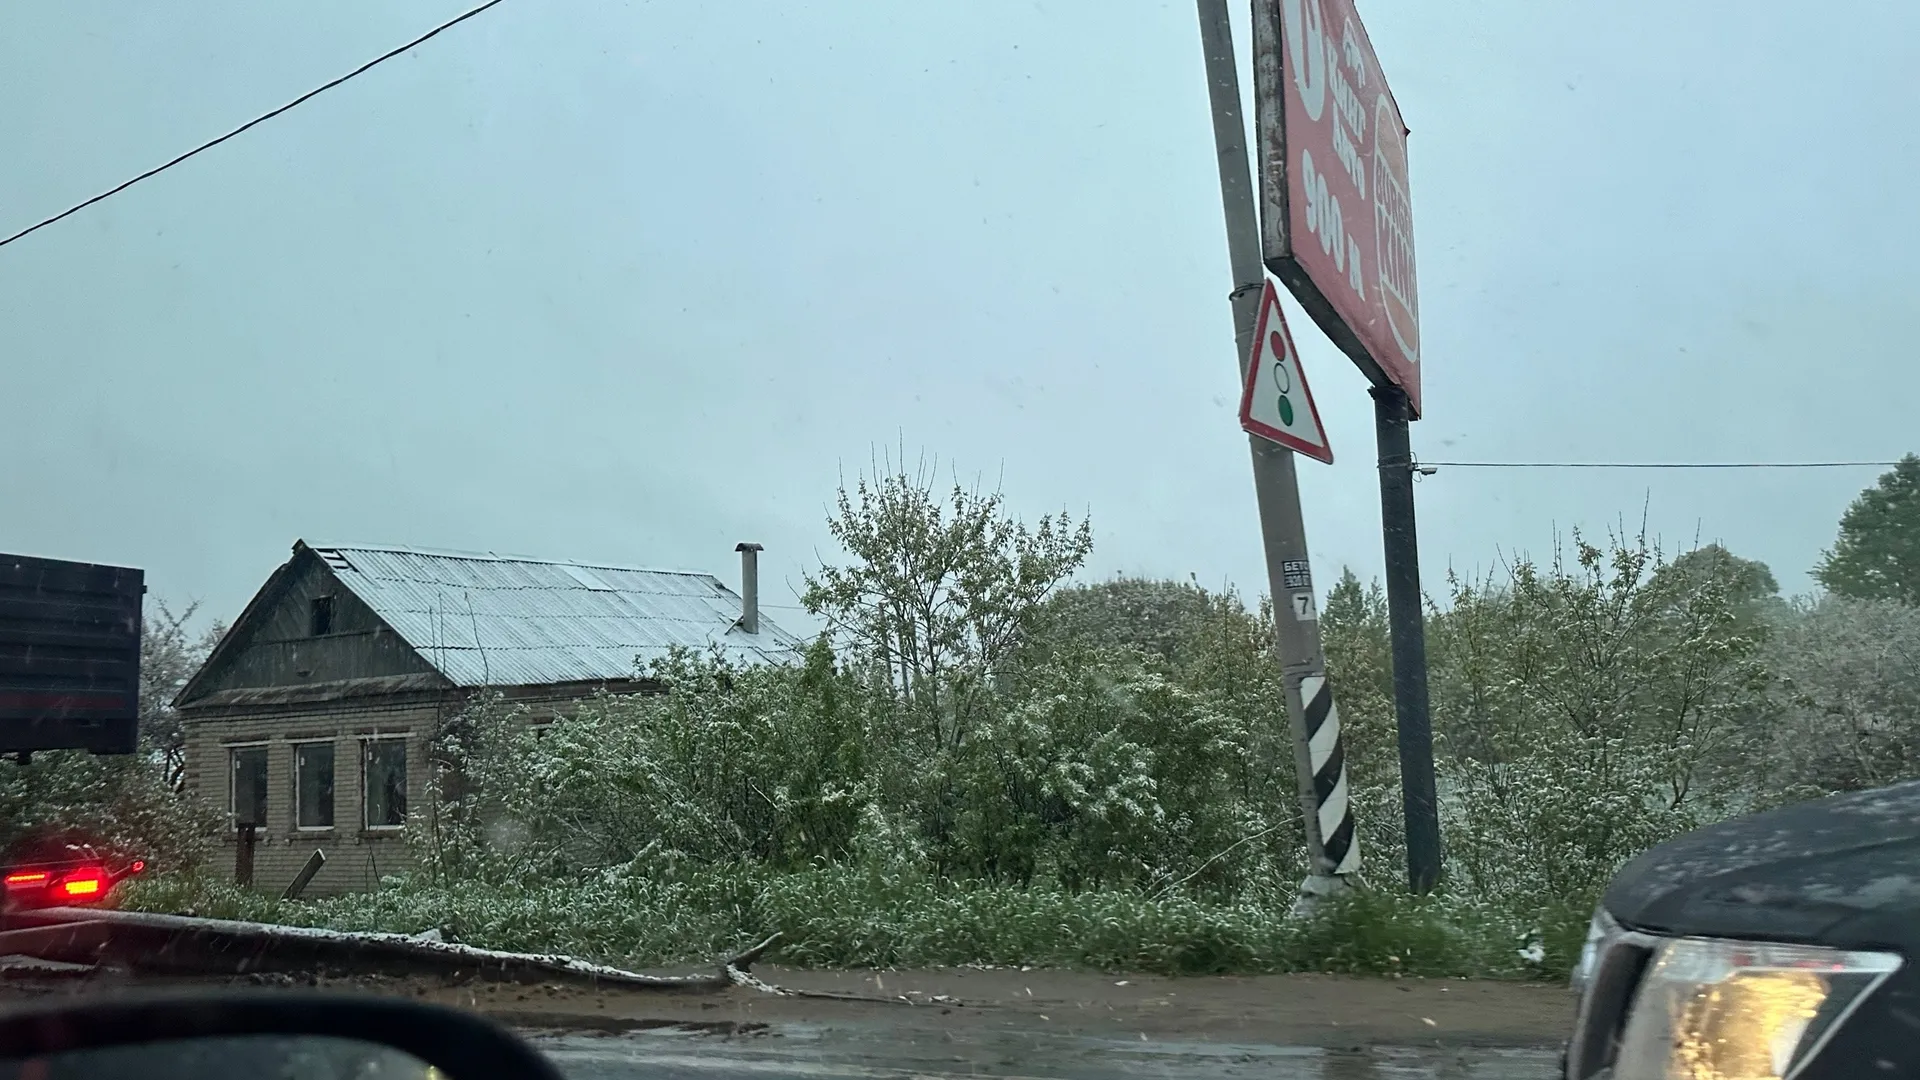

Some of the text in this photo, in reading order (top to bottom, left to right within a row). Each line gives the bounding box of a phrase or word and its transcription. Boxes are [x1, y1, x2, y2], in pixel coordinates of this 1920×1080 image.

[1326, 35, 1366, 144] Кинг
[1332, 99, 1365, 200] Авто
[1303, 149, 1344, 273] 900
[1377, 203, 1416, 317] KING
[1297, 596, 1309, 615] 7
